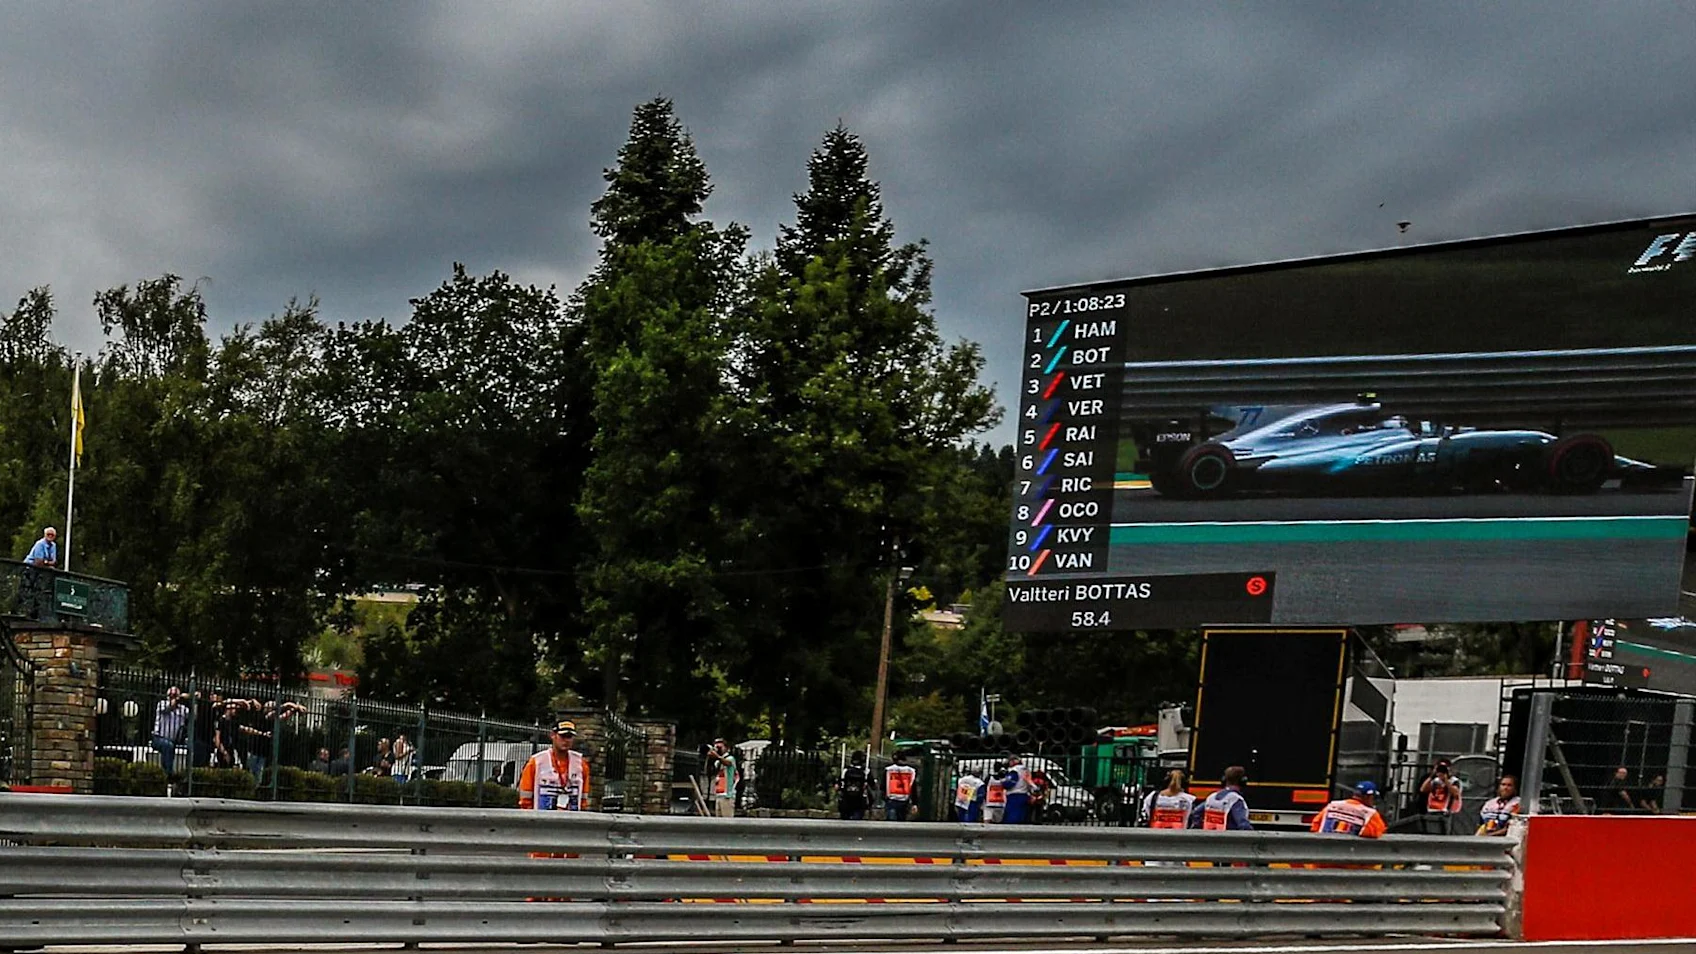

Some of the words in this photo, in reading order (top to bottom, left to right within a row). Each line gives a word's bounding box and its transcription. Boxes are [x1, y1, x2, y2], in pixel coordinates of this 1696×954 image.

[1032, 328, 1042, 343] 1
[1074, 320, 1116, 339] HAM
[1030, 353, 1041, 369] 2
[1072, 346, 1111, 365] BOT
[1027, 379, 1040, 394] 3
[1070, 373, 1105, 390] VET
[1025, 404, 1038, 420] 4
[1068, 399, 1104, 416] VER
[1023, 429, 1035, 445] 5
[1065, 425, 1096, 442] RAI
[1022, 455, 1034, 470] 6
[1063, 451, 1094, 468] SAI
[1020, 480, 1031, 496] 7
[1061, 477, 1092, 493] RIC
[1017, 505, 1030, 521] 8
[1059, 501, 1099, 519] OCO
[1015, 530, 1028, 546] 9
[1057, 526, 1095, 544] KVY
[1008, 555, 1031, 571] 10
[1055, 552, 1093, 569] VAN
[1008, 586, 1071, 603] Valtteri
[1075, 583, 1152, 601] BOTTAS
[1071, 610, 1112, 627] 58.4
